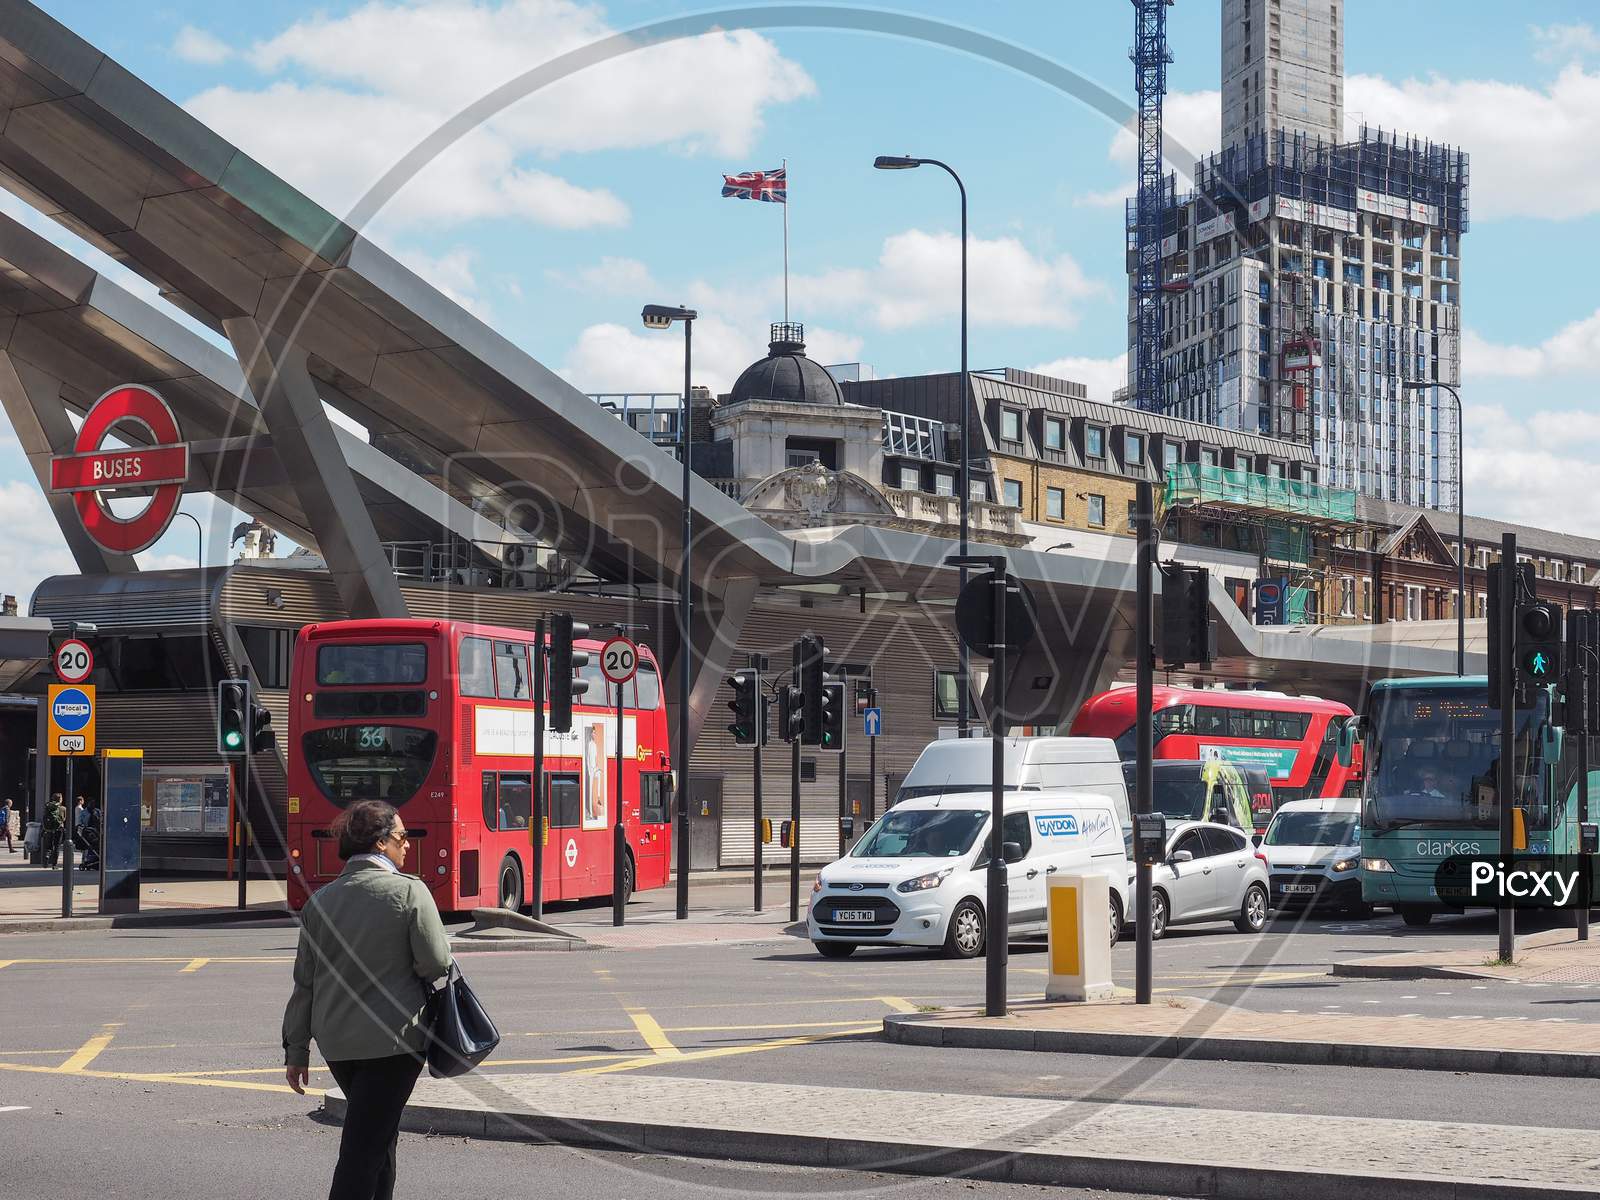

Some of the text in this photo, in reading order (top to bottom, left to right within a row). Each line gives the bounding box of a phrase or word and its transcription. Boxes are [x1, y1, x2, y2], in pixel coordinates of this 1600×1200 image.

[94, 457, 142, 480] BUSES
[61, 651, 88, 669] 20
[606, 650, 634, 670] 20
[62, 739, 82, 748] Only
[359, 726, 385, 748] 36
[1039, 820, 1076, 832] HAYDON
[1416, 839, 1481, 856] clarkes
[838, 911, 856, 920] YC15
